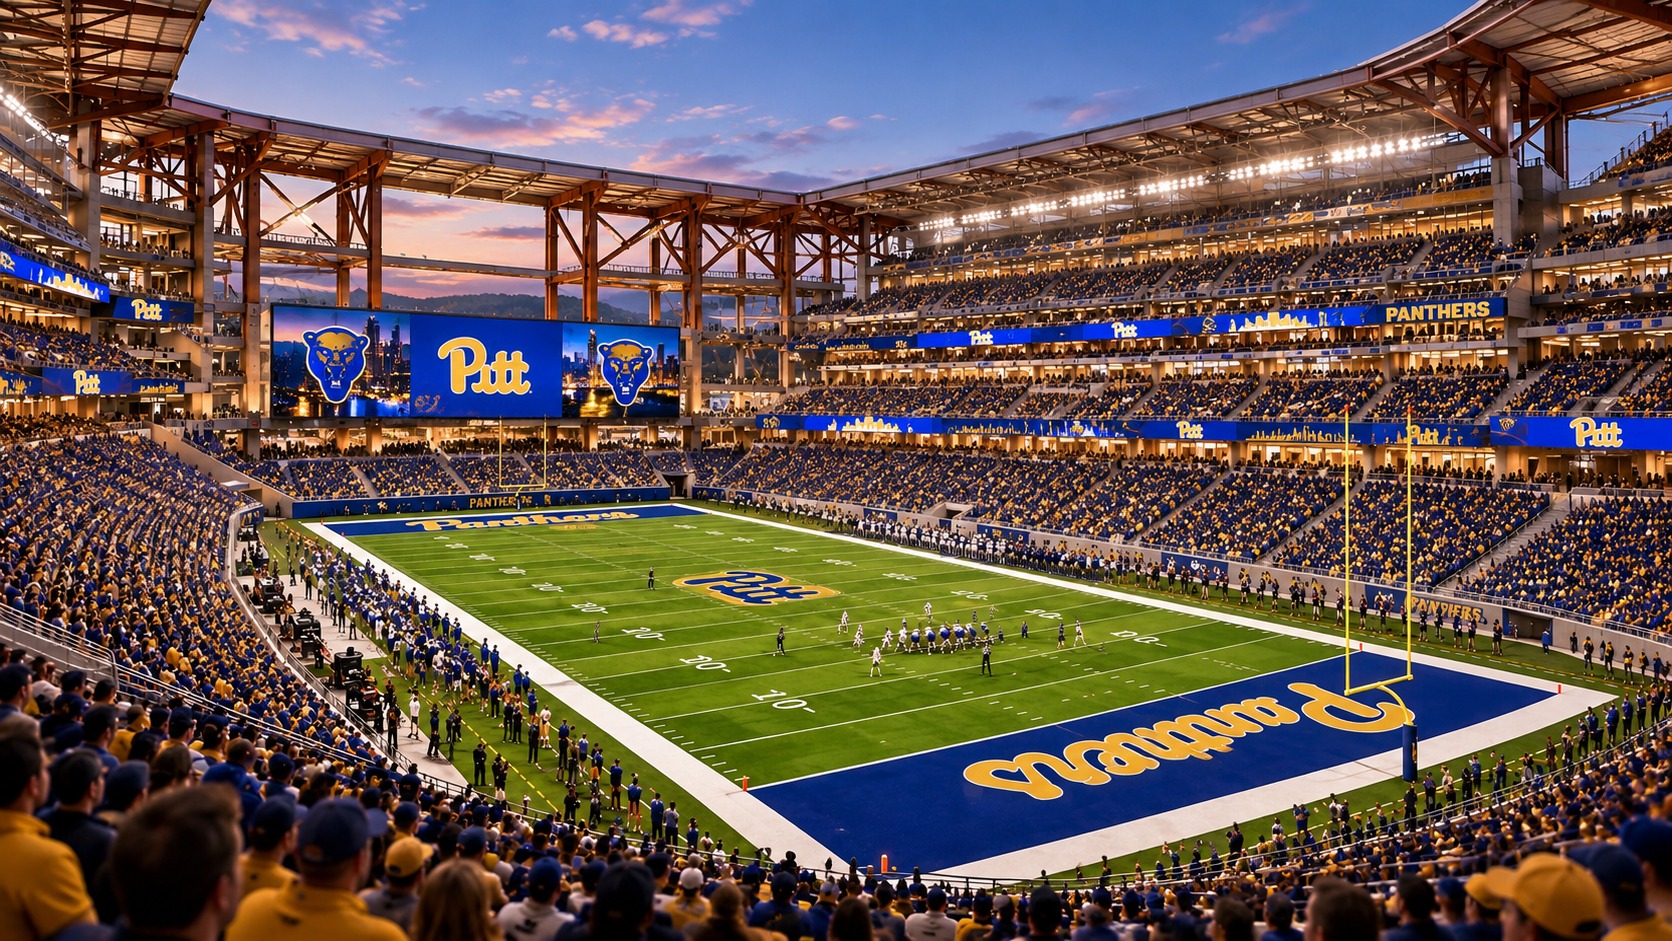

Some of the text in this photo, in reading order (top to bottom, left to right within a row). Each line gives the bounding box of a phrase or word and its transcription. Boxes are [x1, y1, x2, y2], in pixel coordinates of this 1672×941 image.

[1386, 301, 1490, 322] PANTHERS
[437, 336, 532, 395] Pitt
[1569, 416, 1624, 447] Pitt
[751, 689, 808, 710] 10
[963, 682, 1416, 801] Panthers
